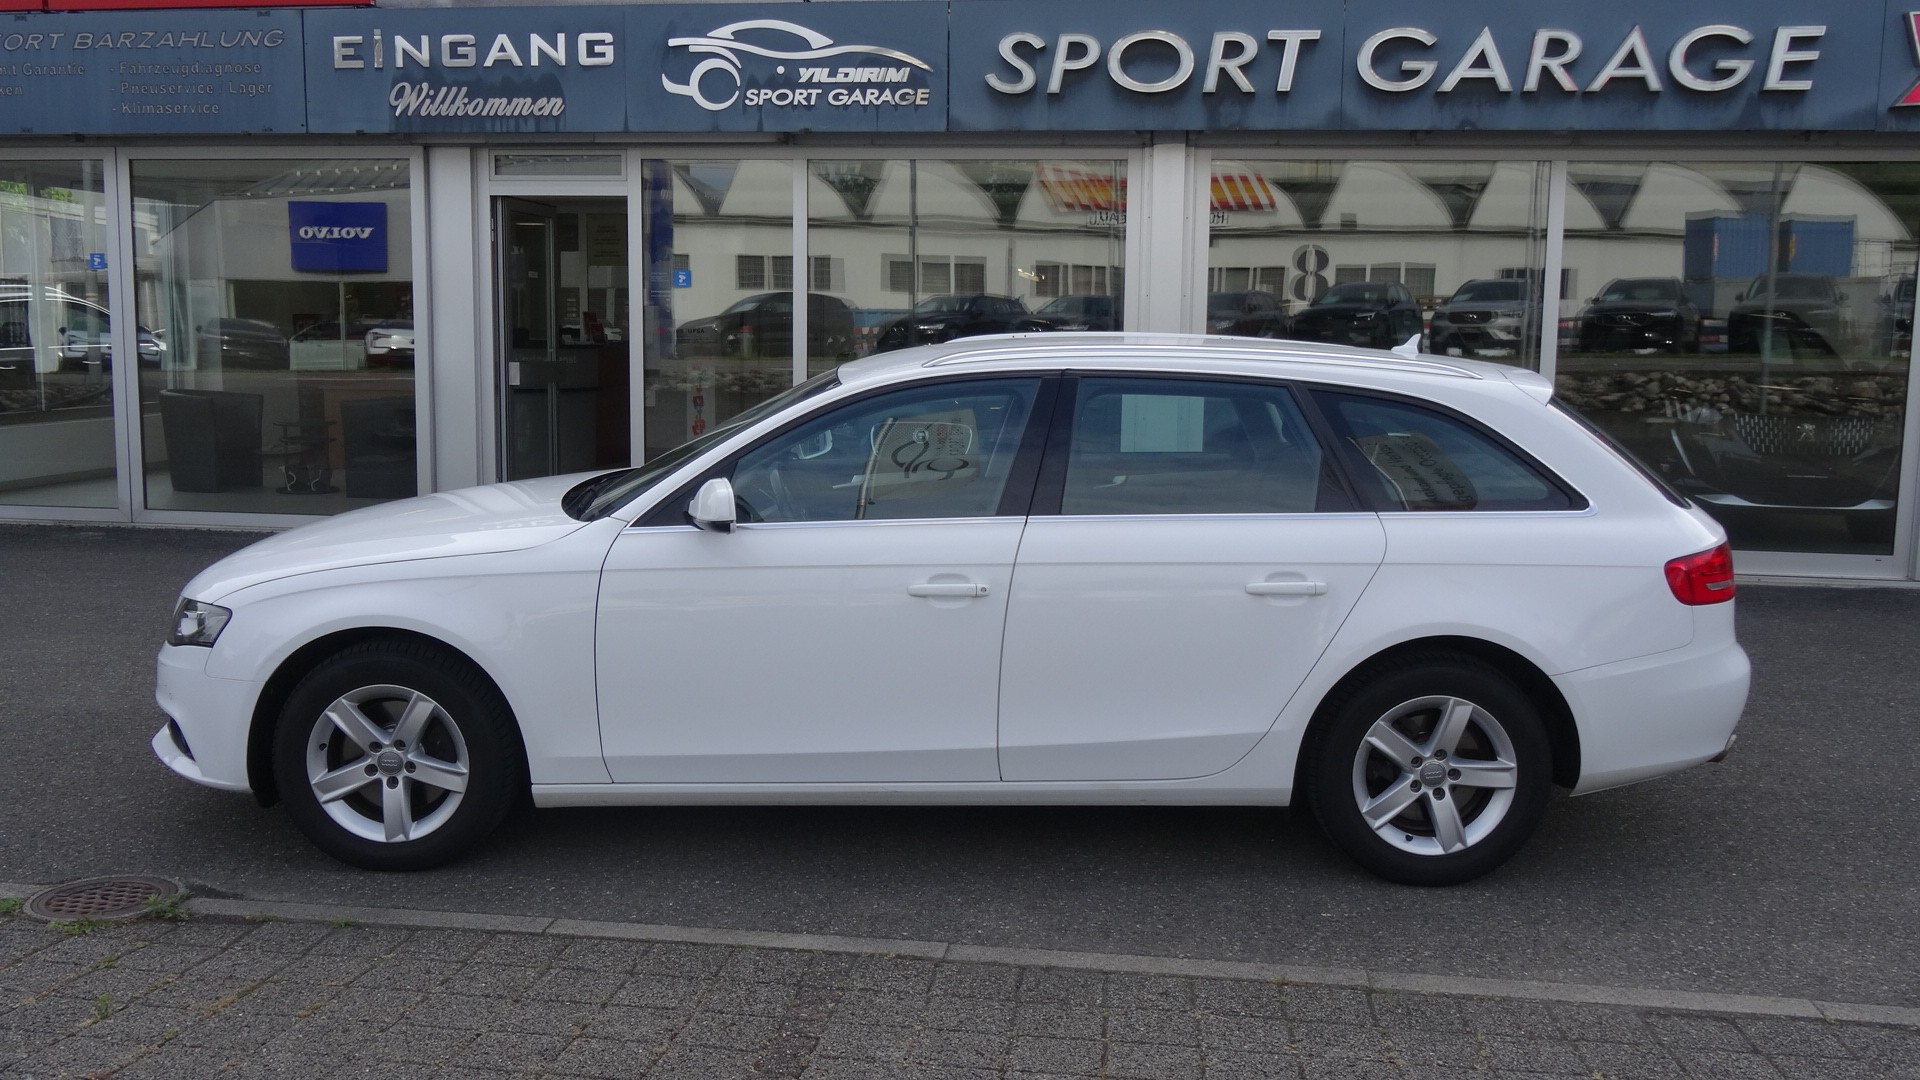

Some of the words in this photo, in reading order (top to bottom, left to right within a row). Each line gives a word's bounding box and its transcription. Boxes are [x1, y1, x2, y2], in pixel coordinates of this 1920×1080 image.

[0, 33, 65, 50] ORT
[73, 29, 285, 50] BARZAHLUNG
[985, 29, 1322, 95] SPORT
[1357, 24, 1827, 92] GARAGE
[22, 62, 85, 76] Garantie
[798, 67, 910, 83] YILDIRIM
[120, 82, 214, 96] Pneuservice
[229, 81, 272, 98] Lager
[744, 88, 822, 106] SPORT
[827, 88, 930, 106] GARAGE
[389, 81, 565, 117] Willkommen
[121, 101, 220, 115] Klimaservice
